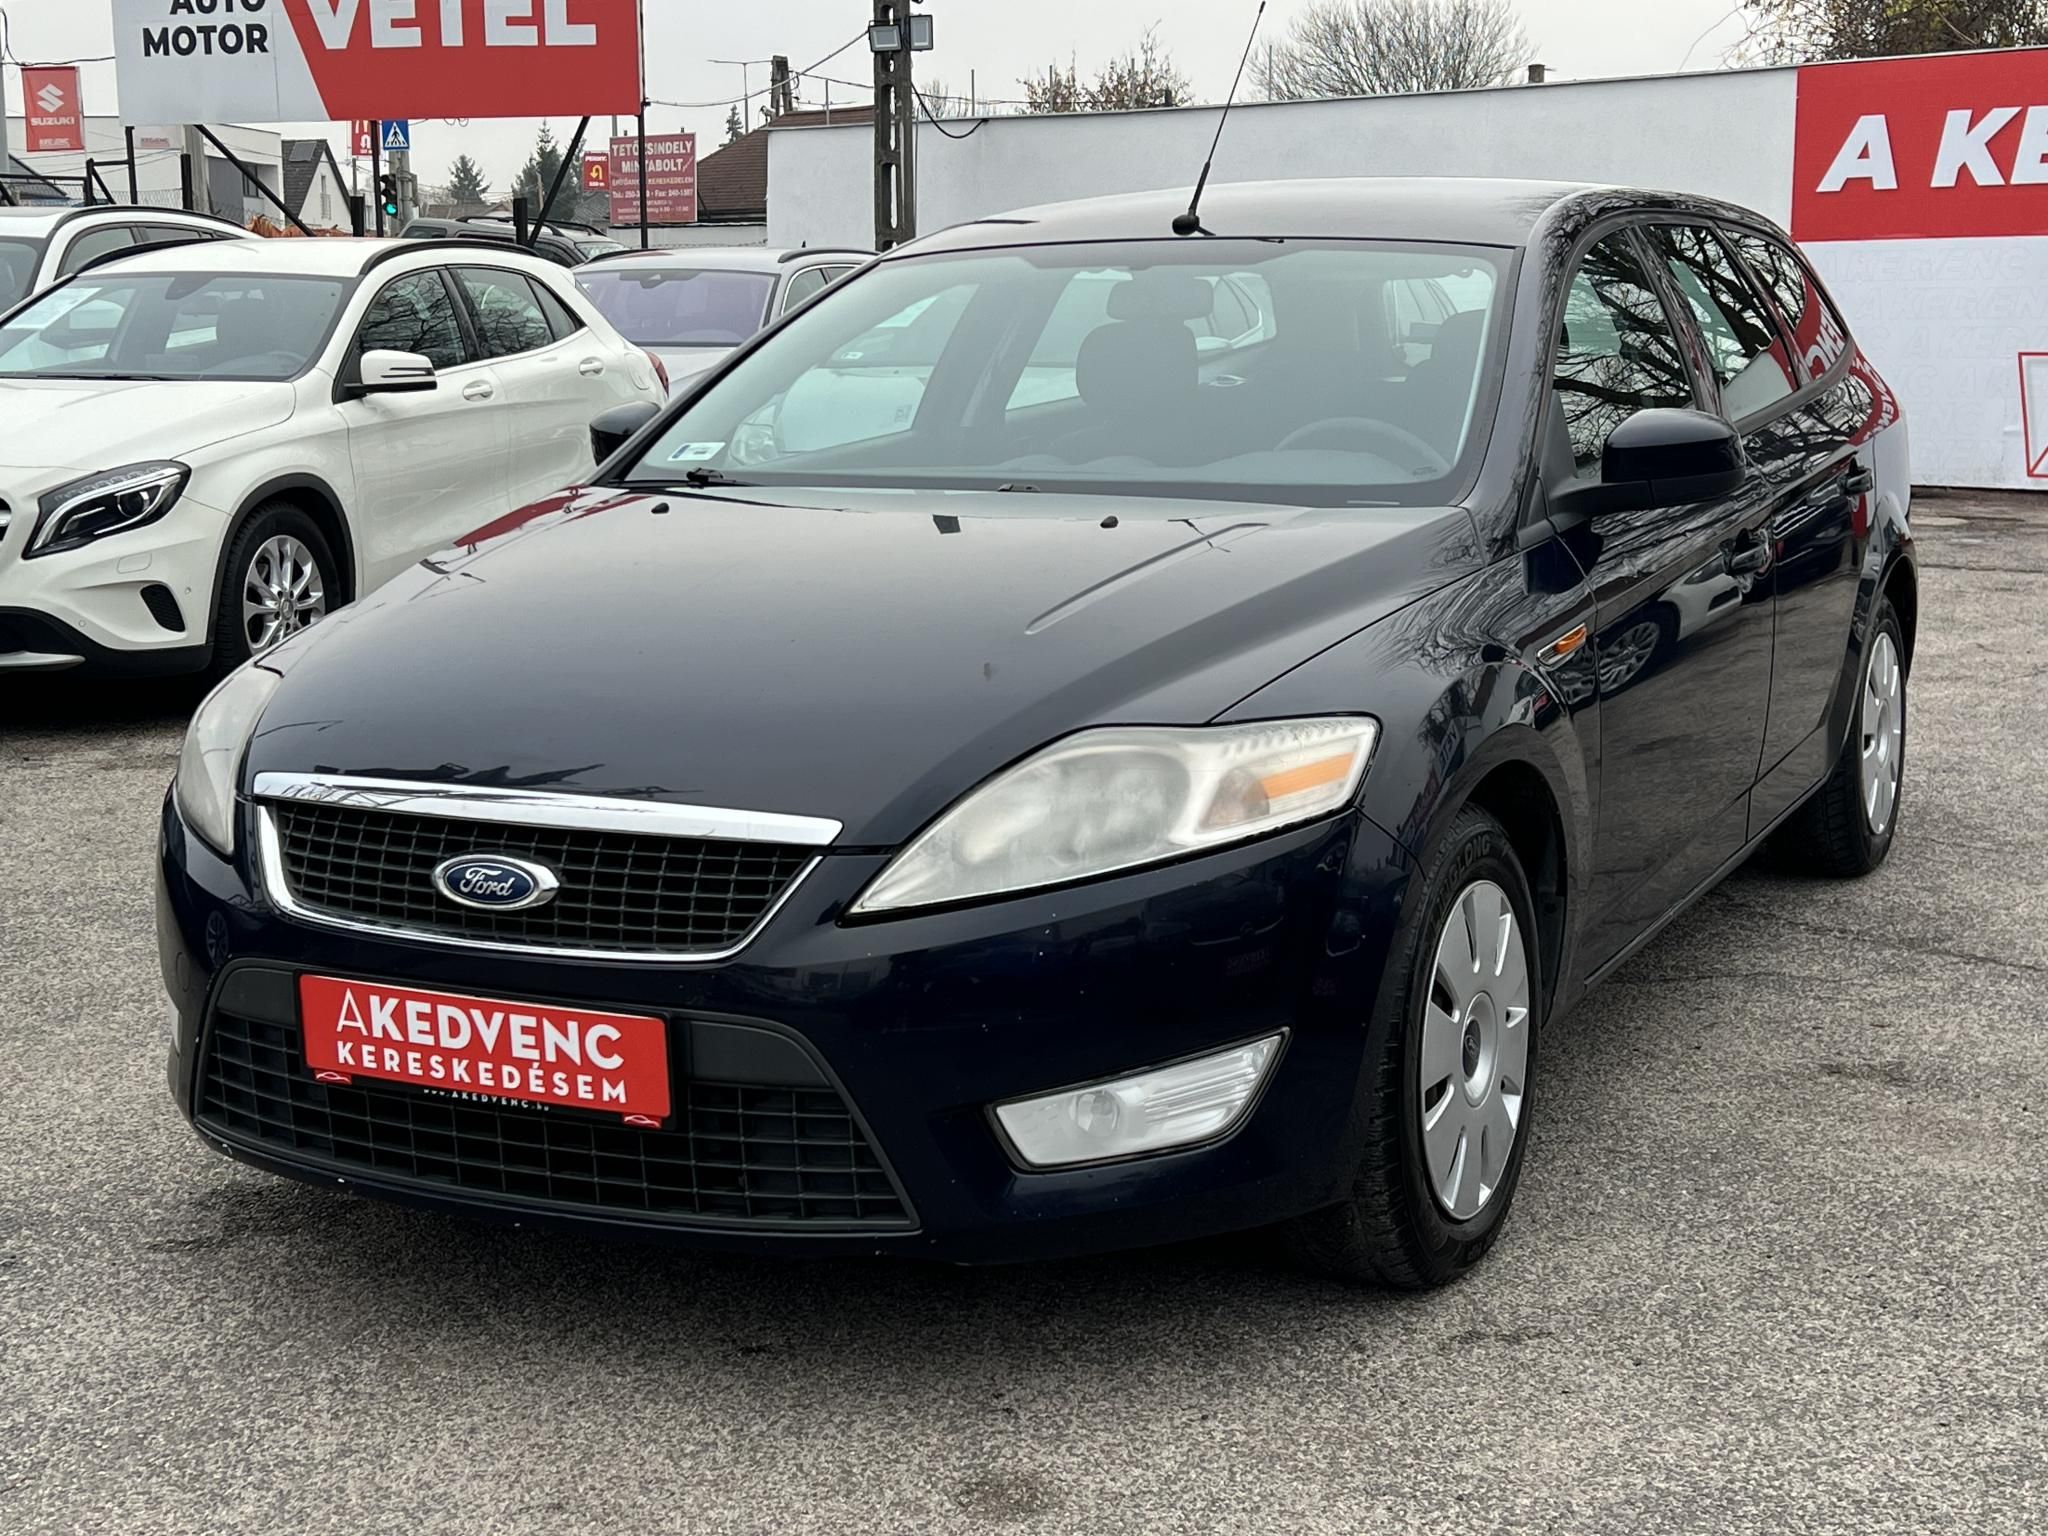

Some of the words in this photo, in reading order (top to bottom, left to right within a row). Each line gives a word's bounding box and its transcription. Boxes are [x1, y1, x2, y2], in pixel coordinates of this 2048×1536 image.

[142, 23, 269, 57] MOTOR
[31, 116, 75, 126] SUZUKI
[611, 140, 693, 157] TETŐSINDELY
[1815, 113, 1899, 193] A
[621, 158, 684, 174] MINABOLT
[460, 866, 515, 897] Ford
[336, 1040, 628, 1104] KERESKEDÉSEM
